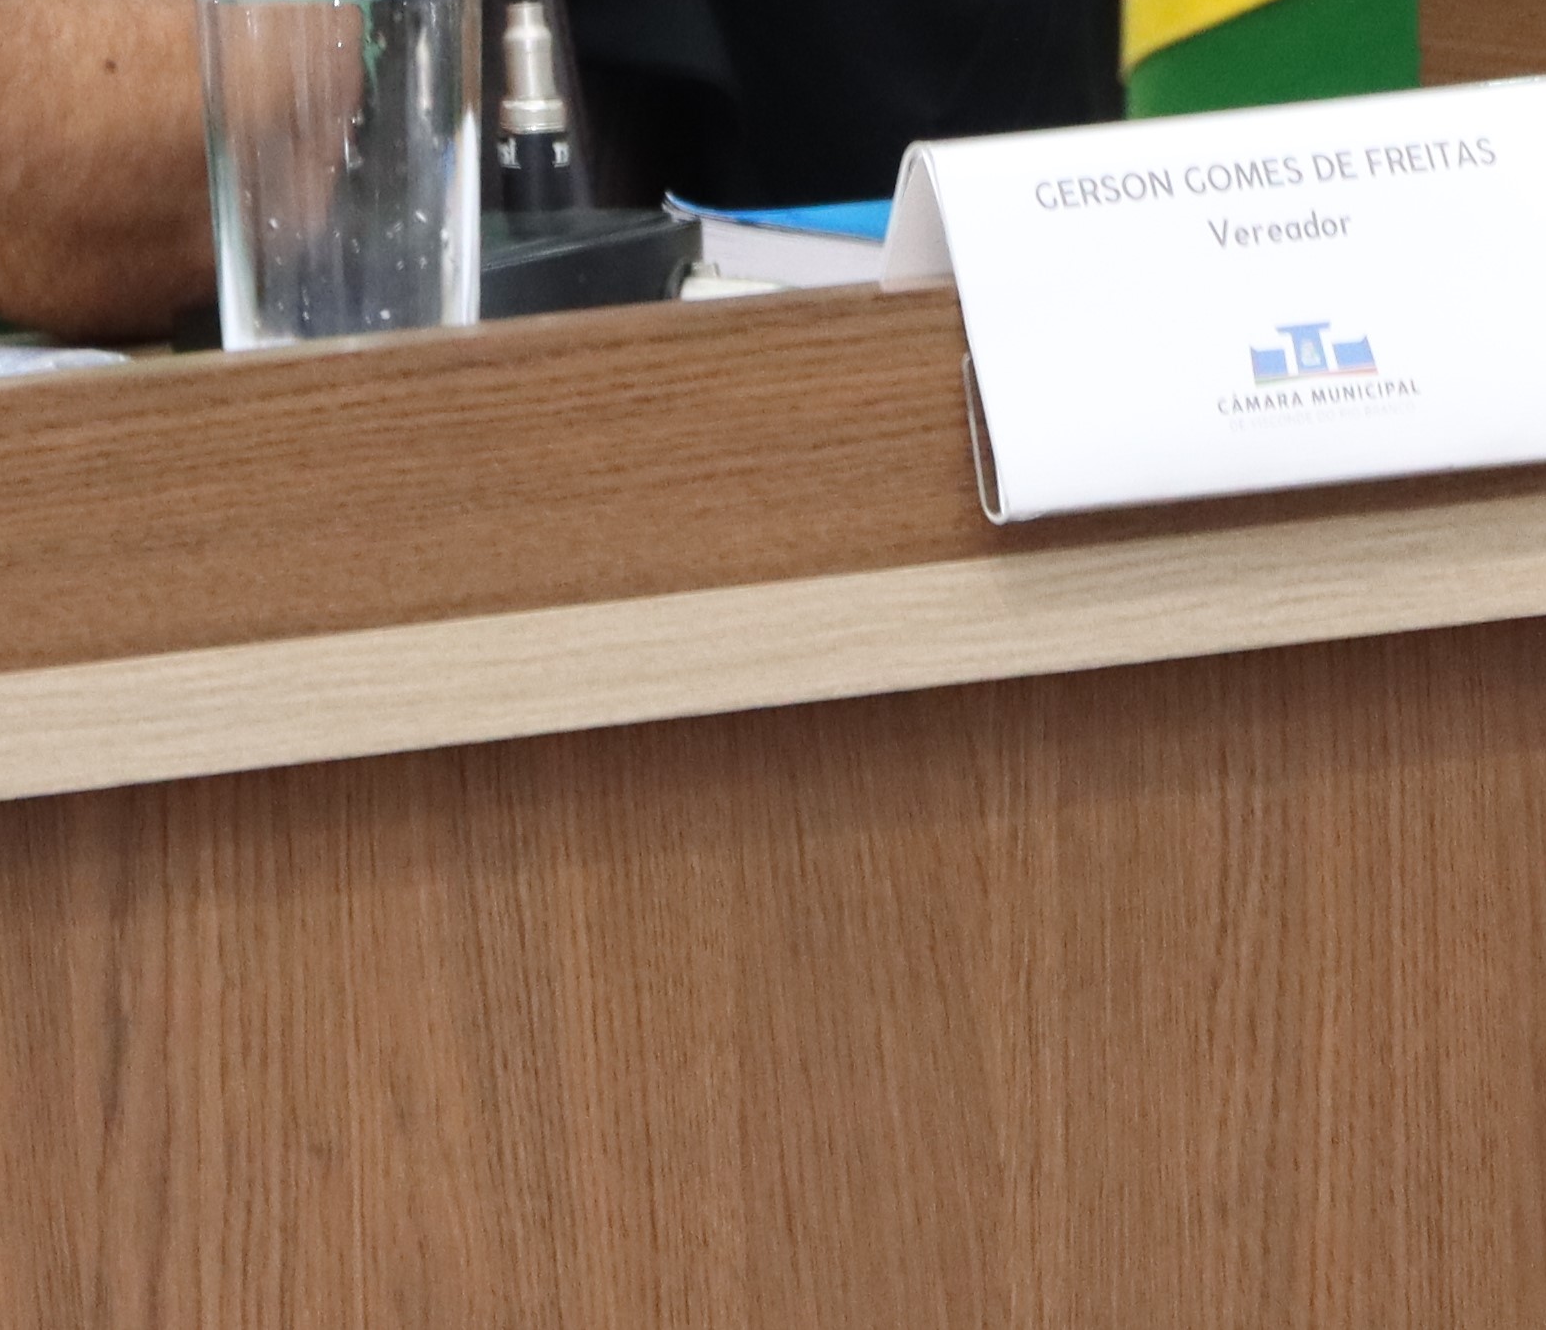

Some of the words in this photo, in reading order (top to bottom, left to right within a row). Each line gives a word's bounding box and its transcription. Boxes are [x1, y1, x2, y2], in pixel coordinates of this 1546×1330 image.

[1034, 169, 1175, 210] GERSON
[1184, 155, 1304, 196] GOMES
[1312, 150, 1358, 183] DE
[1365, 137, 1497, 177] FREITAS
[1208, 208, 1351, 249] Vereador
[1310, 378, 1421, 405] MUNICIPAL
